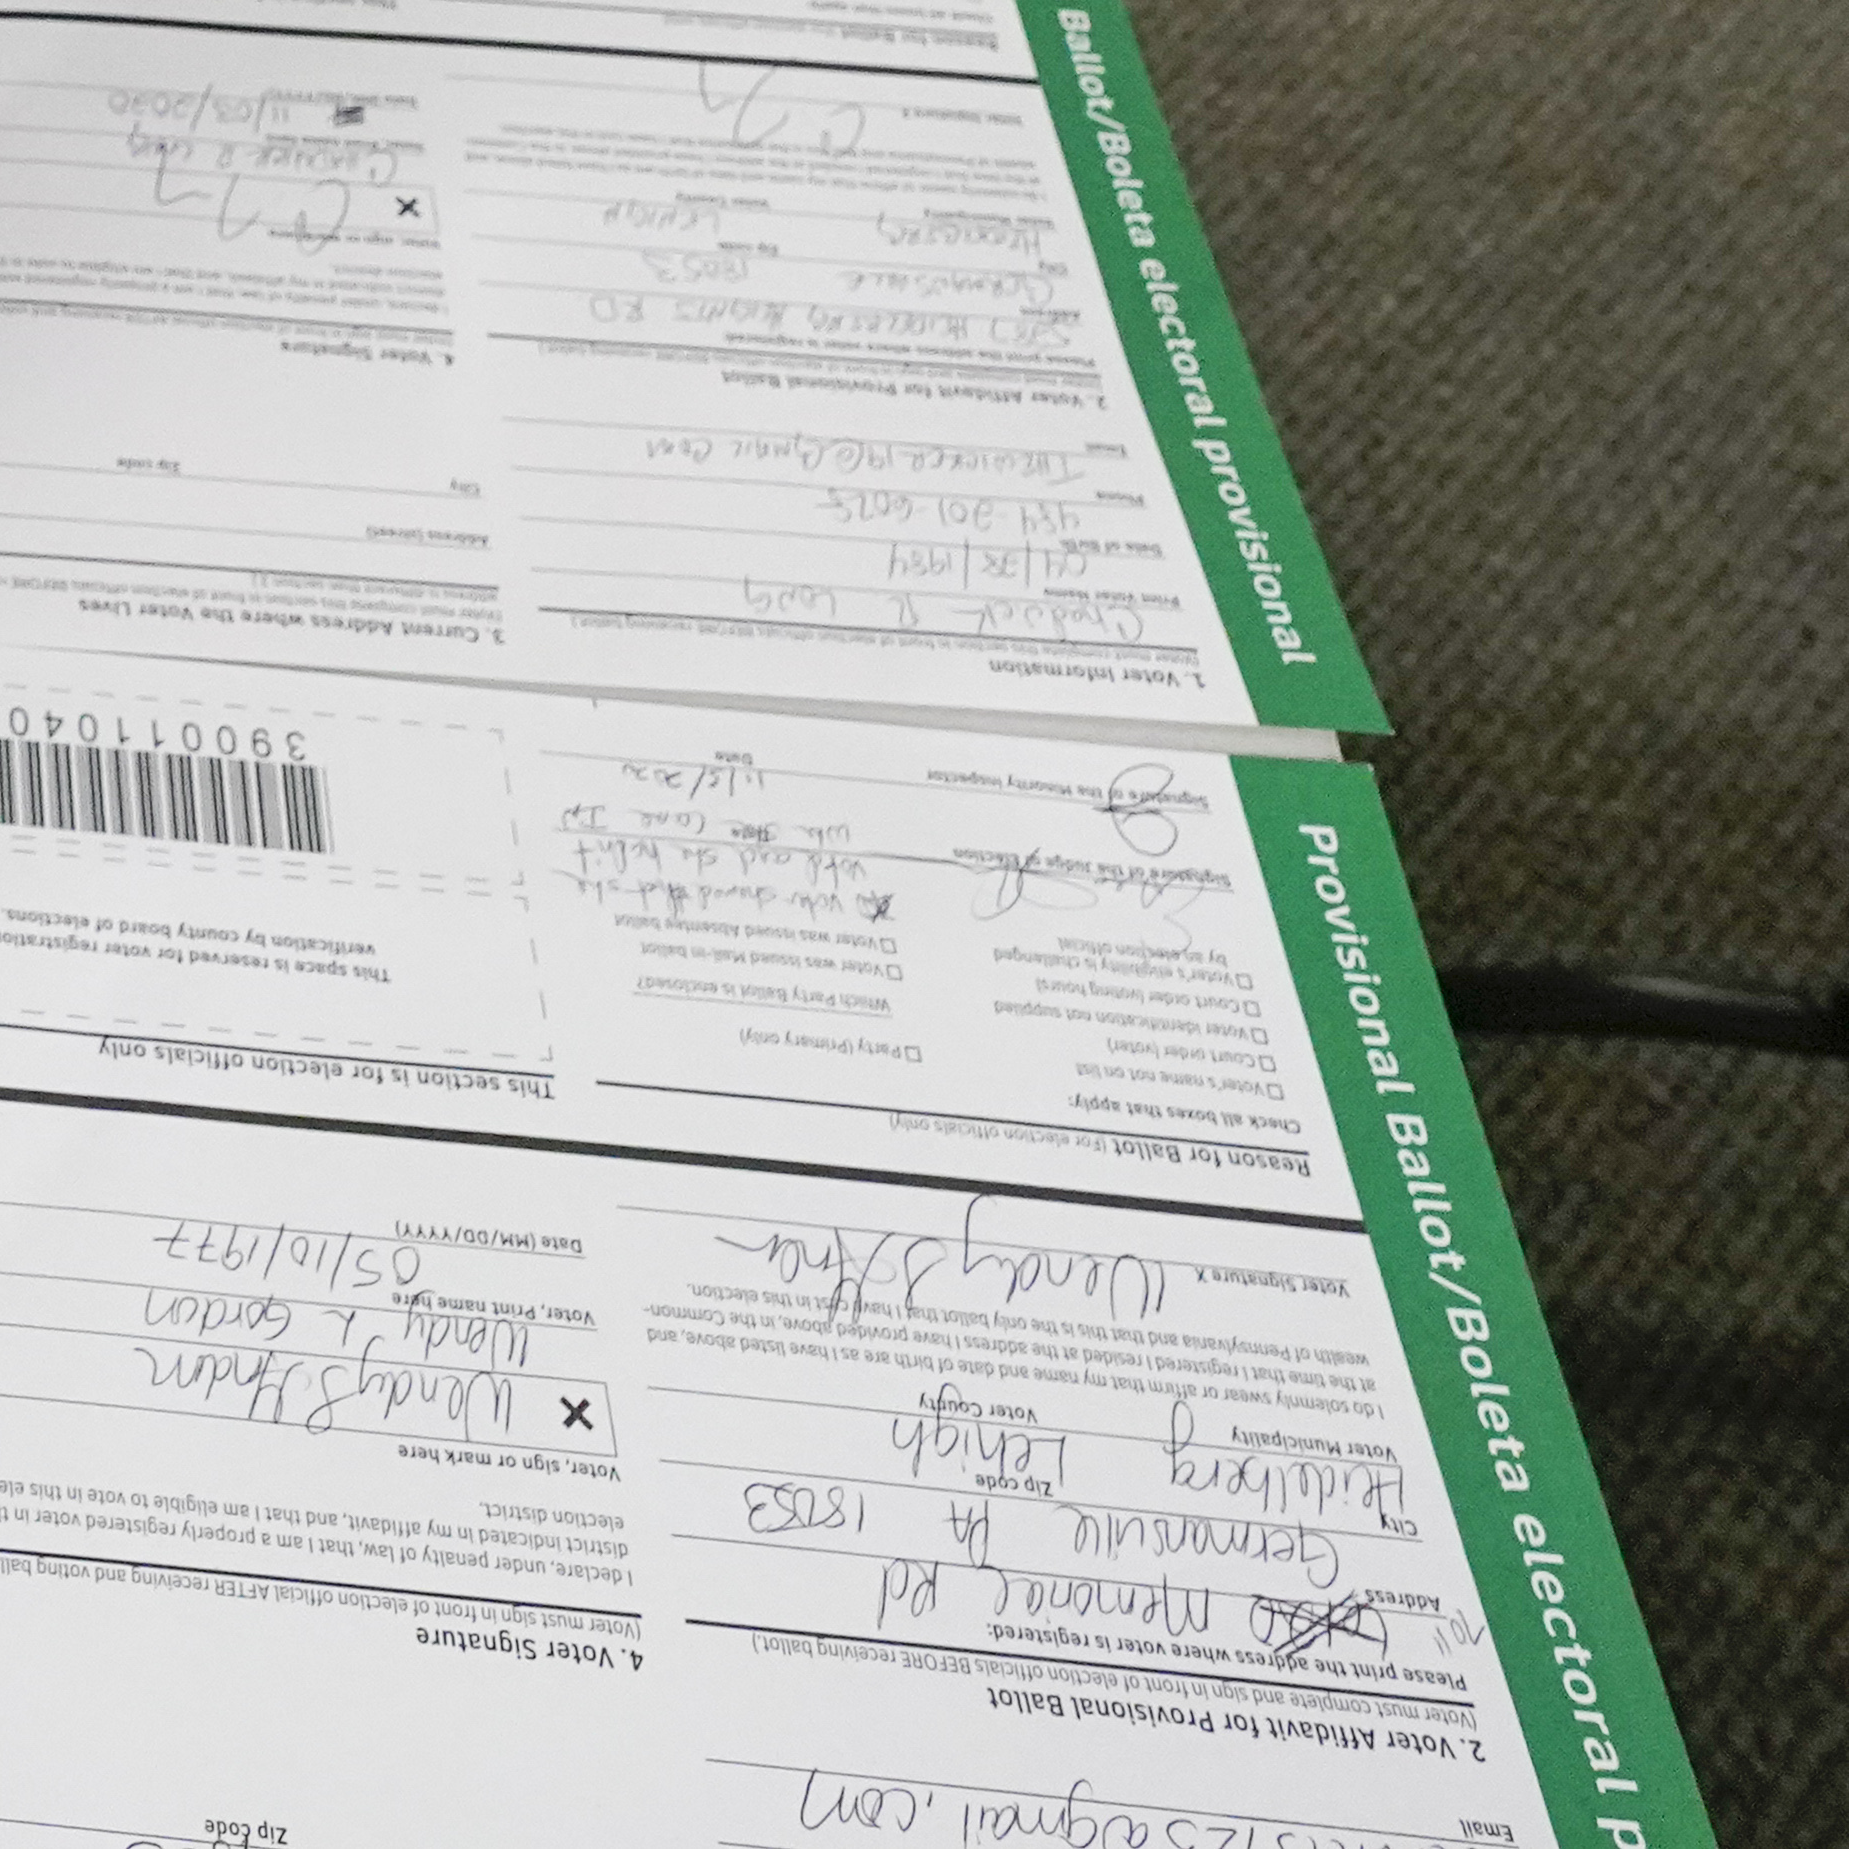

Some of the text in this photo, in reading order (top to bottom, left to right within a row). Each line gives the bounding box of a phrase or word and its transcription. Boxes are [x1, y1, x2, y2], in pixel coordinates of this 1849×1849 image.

[1055, 7, 1156, 248] Ballot/Boleta
[1137, 257, 1317, 665] electoral provisional
[7, 706, 306, 762] 390011040
[97, 1036, 556, 1101] This section is for election officials only
[1111, 1137, 1311, 1178] Reason for Ballot
[387, 1219, 583, 1254] Date (MM/DD/YYYY)
[1297, 823, 1416, 1095] Provisional
[1384, 1112, 1531, 1492] Ballot/Boleta
[1511, 1512, 1637, 1794] electoral
[918, 1392, 1038, 1424] Voter County
[397, 1443, 621, 1483] Voter, sign or mark here
[892, 1384, 1405, 1516] Heidelberg Lehigh
[1230, 1424, 1398, 1463] Voter Municipality
[974, 1471, 1054, 1498] Zip code
[744, 1481, 1340, 1590] Germansville PA 18053
[1378, 1512, 1418, 1537] City
[878, 1558, 1210, 1637] Memorial Rd
[1358, 1588, 1440, 1613] Address
[415, 1626, 644, 1672] 4. Voter Signature
[986, 1622, 1468, 1692] Please print the address where voter is registered:
[985, 1686, 1486, 1763] 2. Voter Affidavit for Provisional Ballot
[1458, 1819, 1515, 1843] Email
